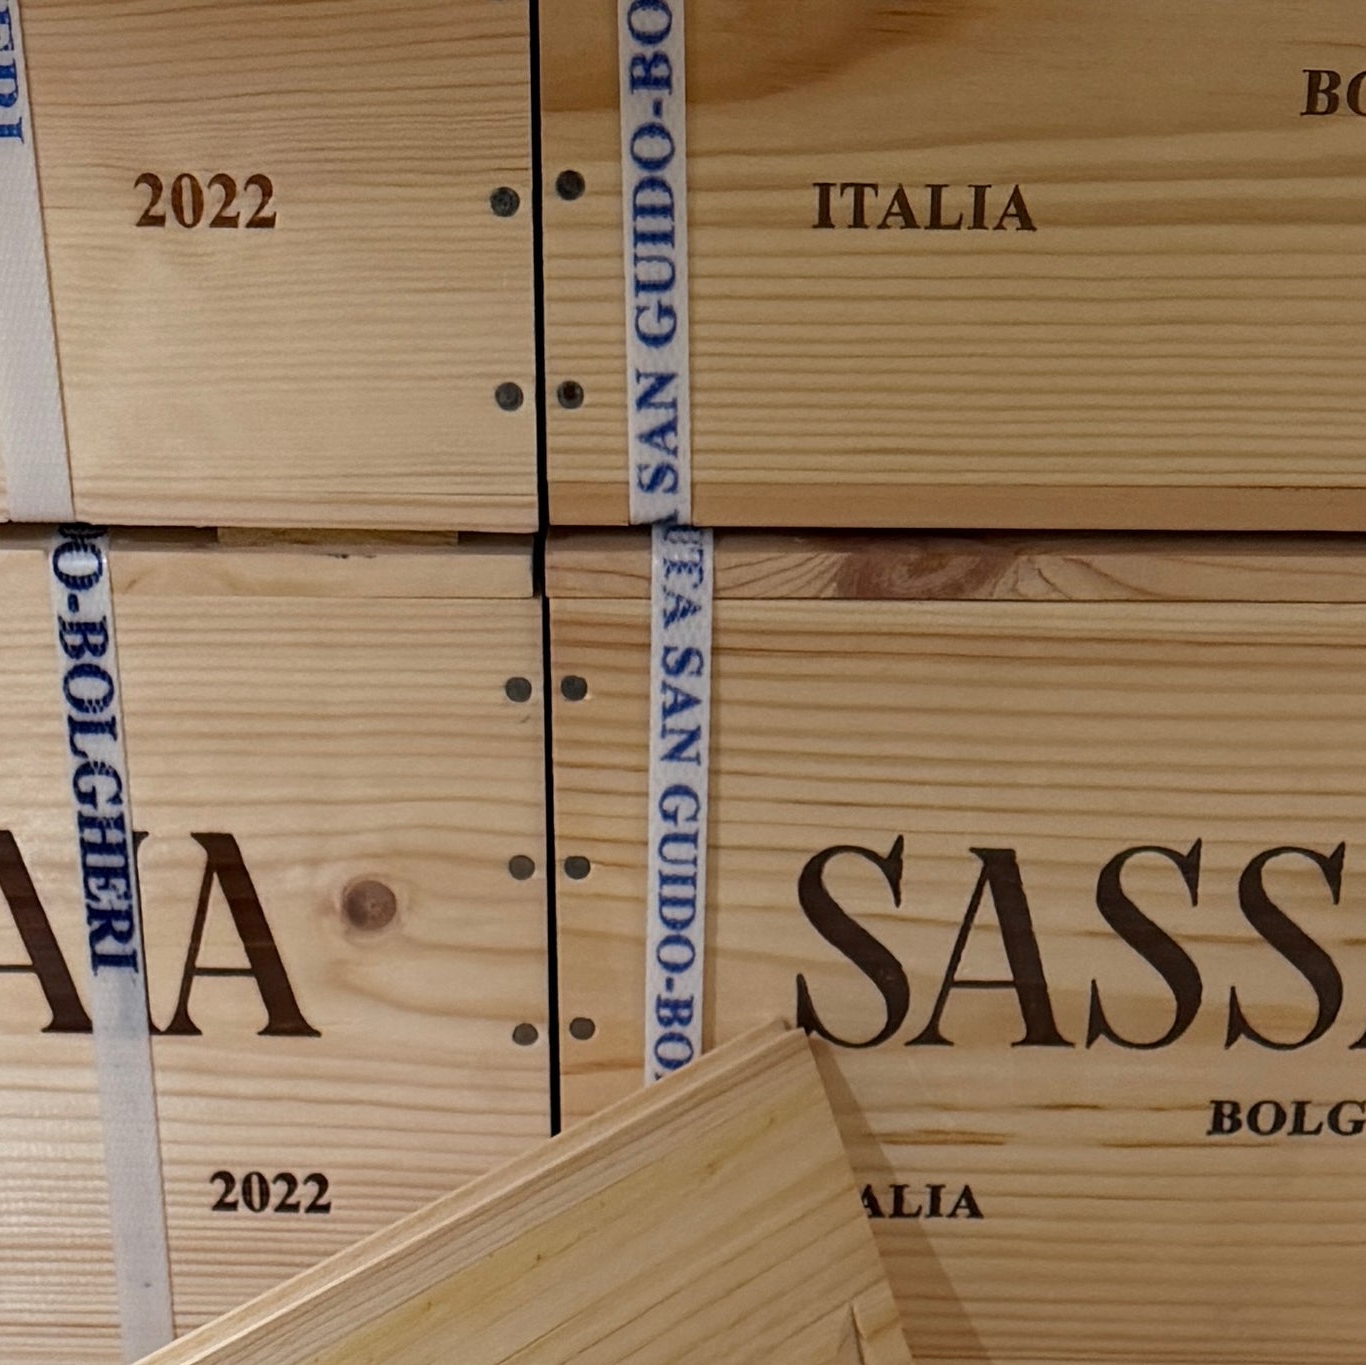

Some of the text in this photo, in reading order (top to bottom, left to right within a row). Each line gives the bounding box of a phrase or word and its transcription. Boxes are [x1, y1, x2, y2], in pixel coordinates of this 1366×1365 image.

[135, 172, 277, 229] 2022
[812, 182, 1037, 231] ITALIA
[636, 369, 678, 494] SAN
[659, 645, 704, 763] SAN
[652, 784, 702, 1082] GUIDO-BO
[208, 1170, 333, 1215] 2022
